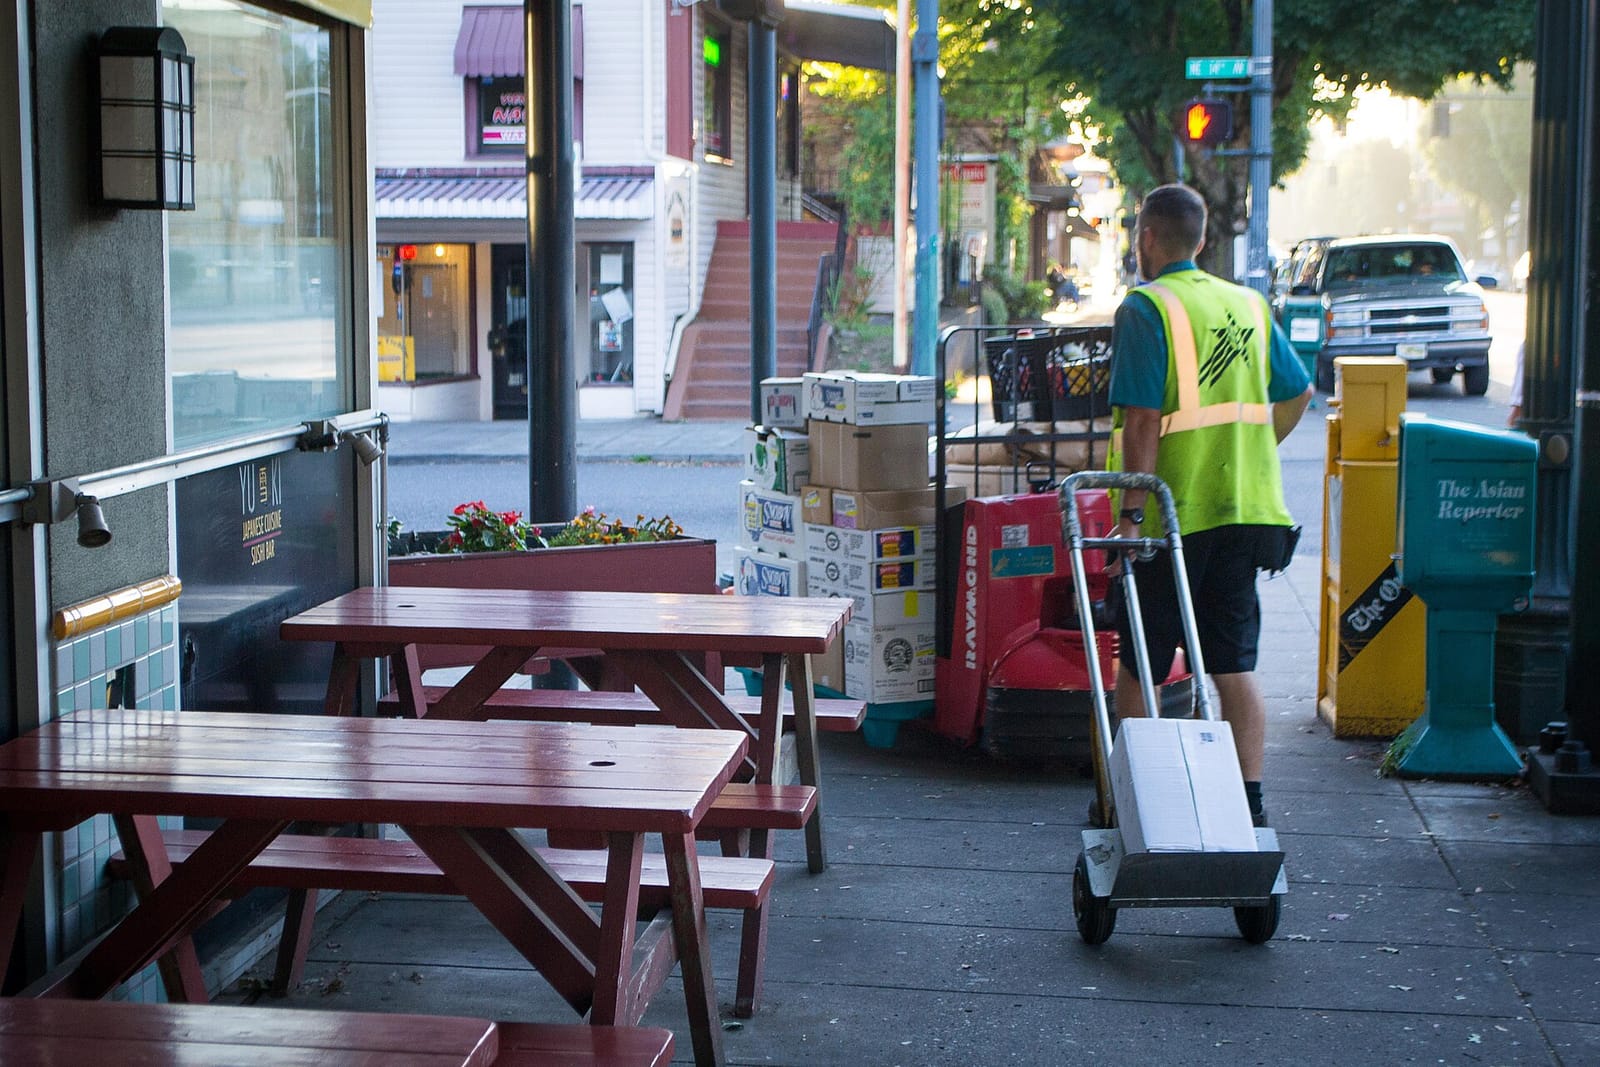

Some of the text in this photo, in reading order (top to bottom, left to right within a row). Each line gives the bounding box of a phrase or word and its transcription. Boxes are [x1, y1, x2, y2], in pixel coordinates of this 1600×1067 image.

[239, 457, 282, 515] YU KI
[1437, 479, 1526, 498] The Asian
[242, 509, 282, 541] JAPANESE CUISINE
[1437, 500, 1526, 522] Reporter
[251, 539, 276, 566] SUSHI BAR
[965, 525, 977, 670] RAYMOND
[1347, 598, 1386, 632] The
